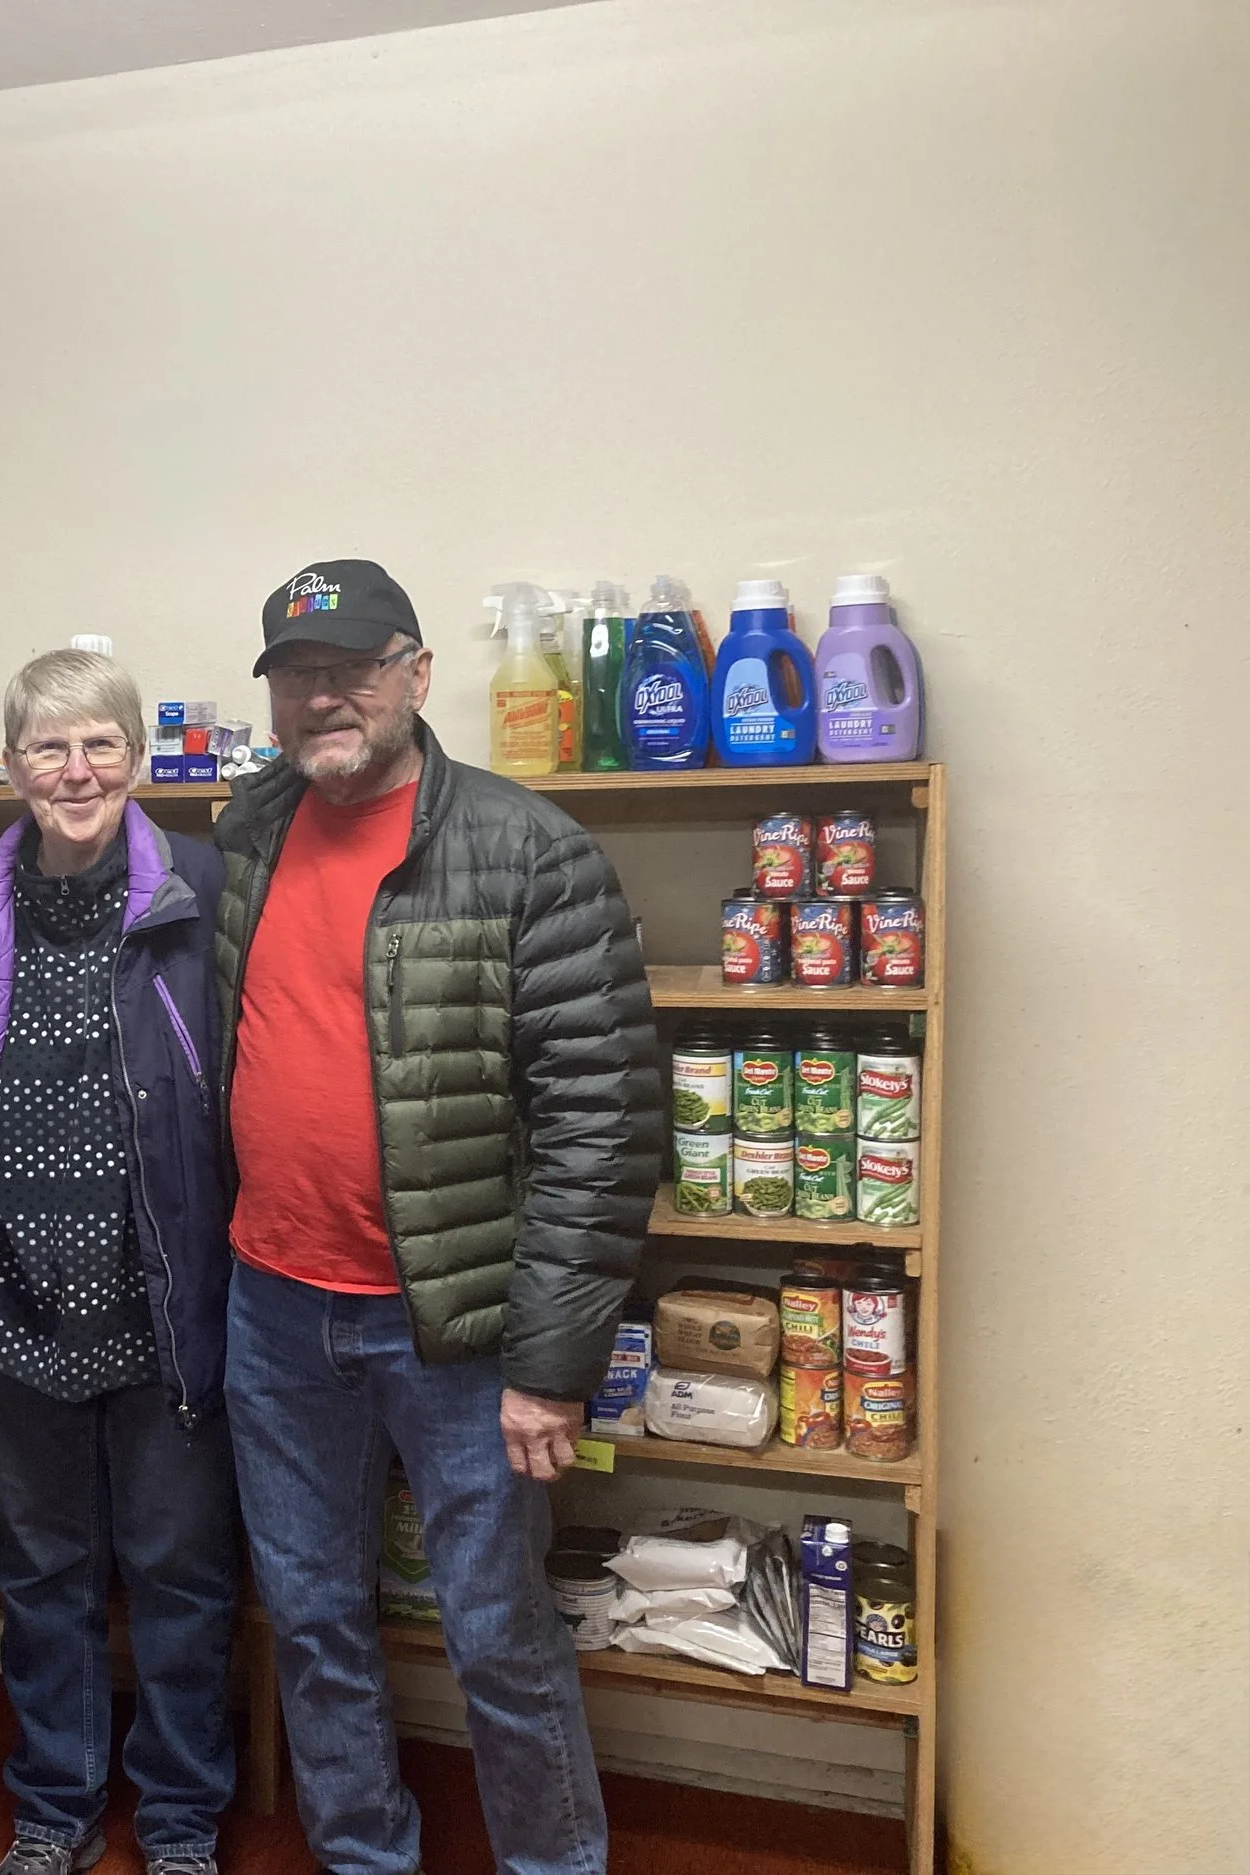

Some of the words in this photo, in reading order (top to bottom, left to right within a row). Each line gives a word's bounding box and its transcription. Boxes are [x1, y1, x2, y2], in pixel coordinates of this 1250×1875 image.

[286, 573, 341, 600] Palm
[727, 686, 768, 716] OXYDOL
[826, 682, 867, 712] OXYDOL
[730, 725, 775, 734] LAUNDRY
[829, 720, 872, 729] LAUNDRY
[823, 825, 858, 844] Vine
[765, 876, 794, 888] Sauce
[841, 874, 869, 886] Sauce
[735, 912, 768, 935] Ripe
[866, 914, 901, 933] Vine
[802, 964, 830, 975] Sauce
[885, 964, 914, 976] Sauce
[678, 1137, 709, 1149] Green
[681, 1147, 710, 1158] Giant
[785, 1322, 813, 1332] CHILI
[848, 1326, 887, 1342] Wendy's
[607, 1369, 637, 1379] NACK
[671, 1390, 693, 1399] ADM
